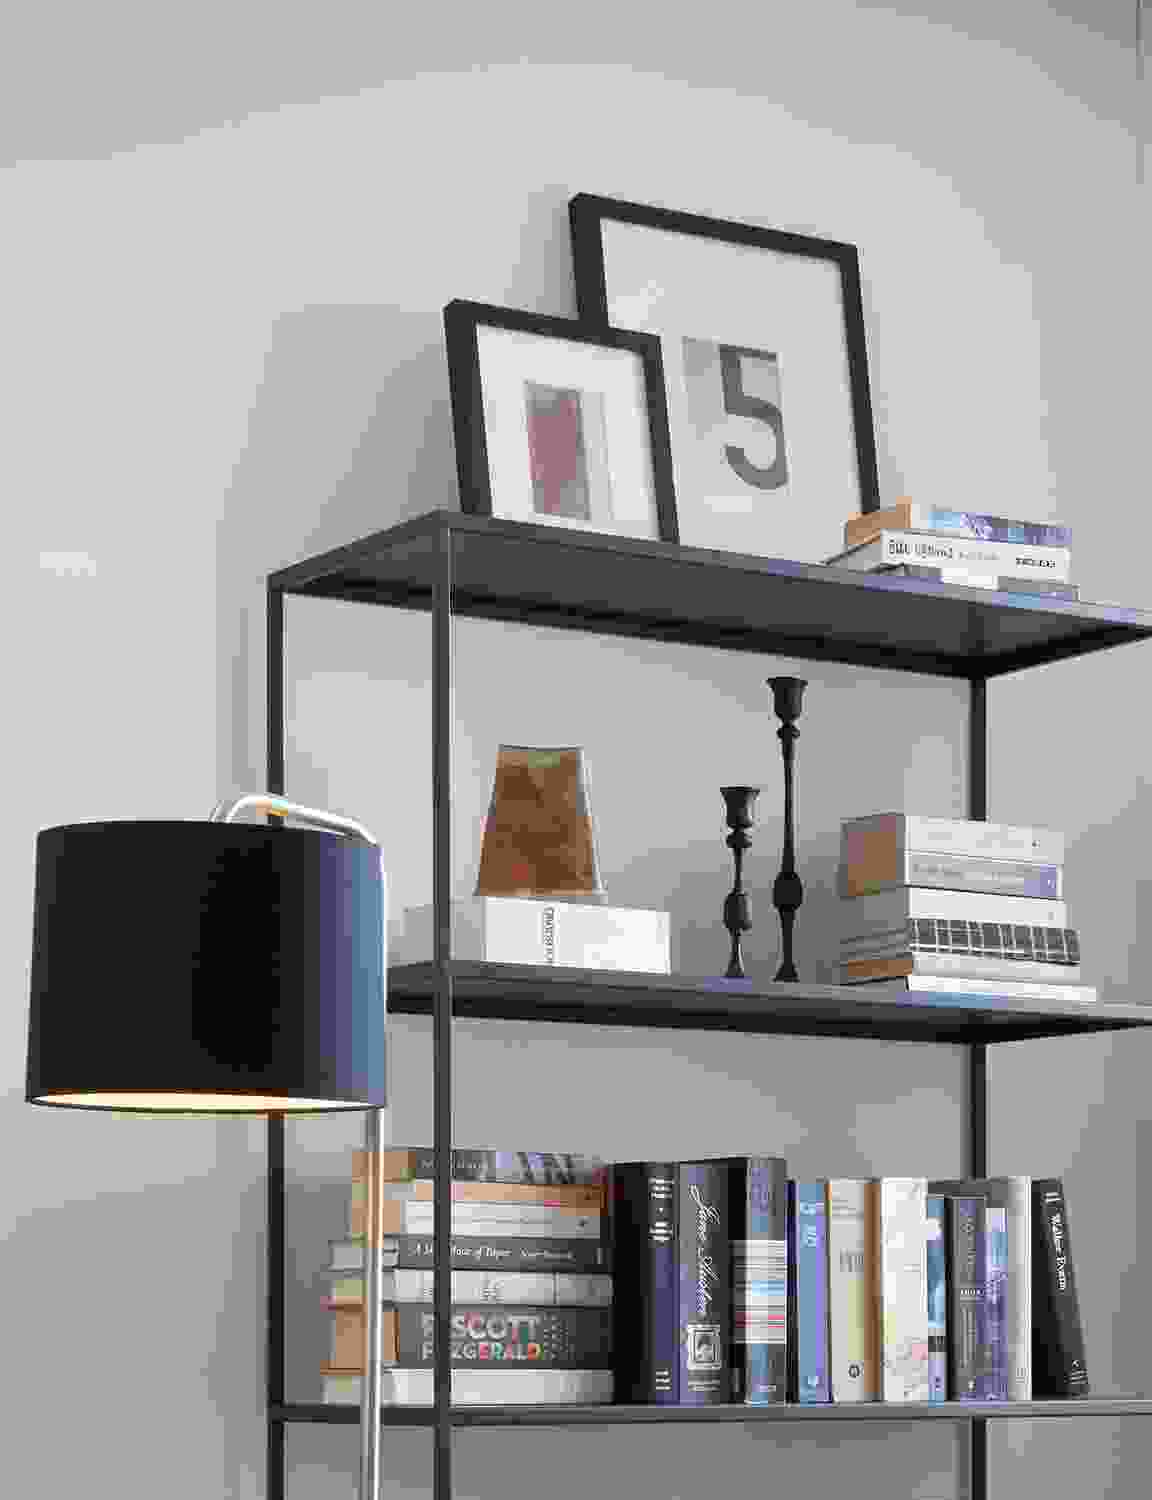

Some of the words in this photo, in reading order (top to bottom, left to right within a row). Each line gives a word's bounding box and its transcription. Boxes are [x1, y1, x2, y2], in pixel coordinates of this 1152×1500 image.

[720, 344, 789, 491] 5
[688, 1184, 721, 1242] Jane
[450, 1312, 541, 1340] SCOTT
[421, 1342, 542, 1361] FZGERALD
